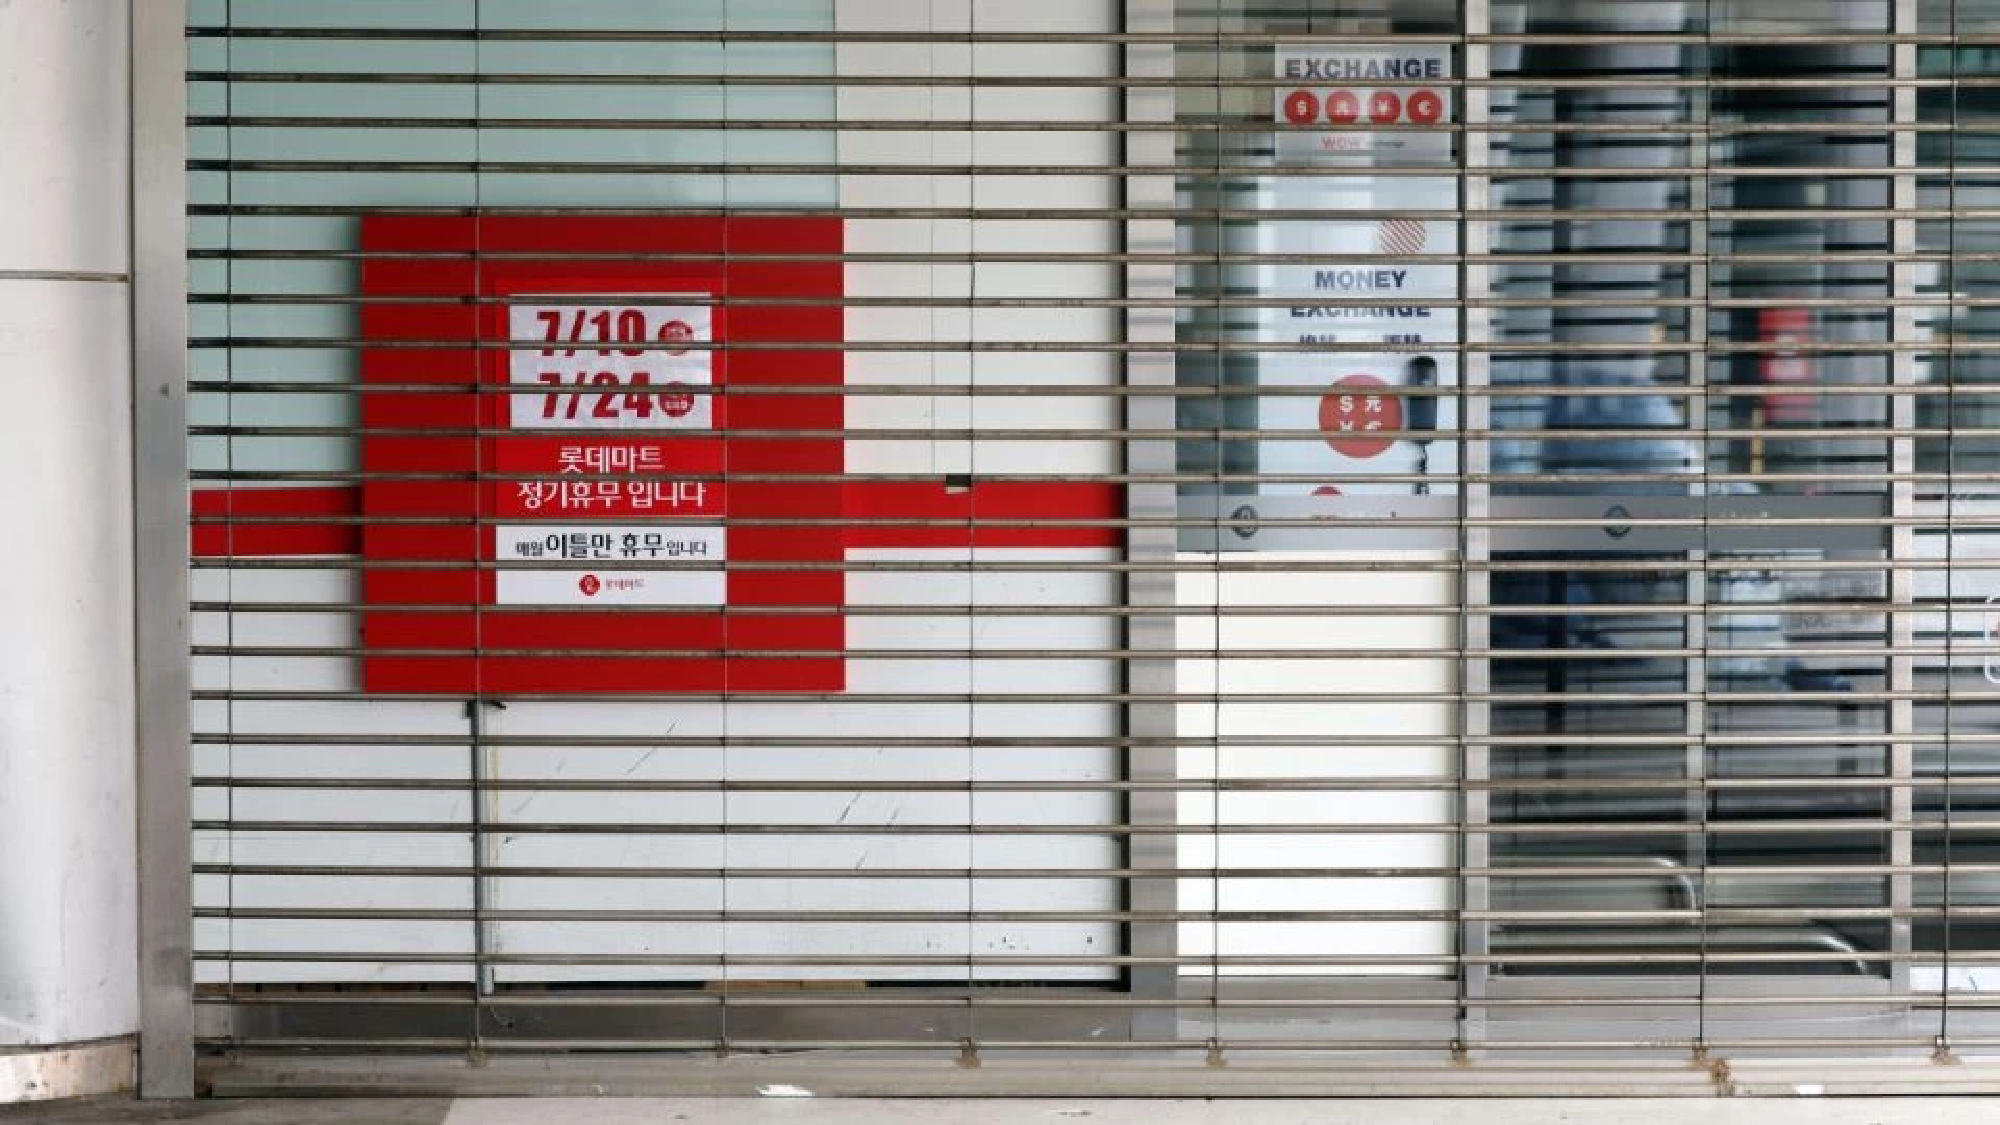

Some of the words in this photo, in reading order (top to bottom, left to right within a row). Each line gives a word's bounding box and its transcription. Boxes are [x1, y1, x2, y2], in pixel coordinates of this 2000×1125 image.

[1284, 57, 1441, 78] EXCHANGE
[1315, 269, 1407, 290] MONEY
[537, 309, 647, 357] 7/10
[539, 372, 653, 419] 7/24
[557, 445, 666, 474] 롯데마트
[517, 480, 624, 510] 정기휴무
[626, 480, 707, 509] 입니다
[545, 533, 615, 559] 이틀만
